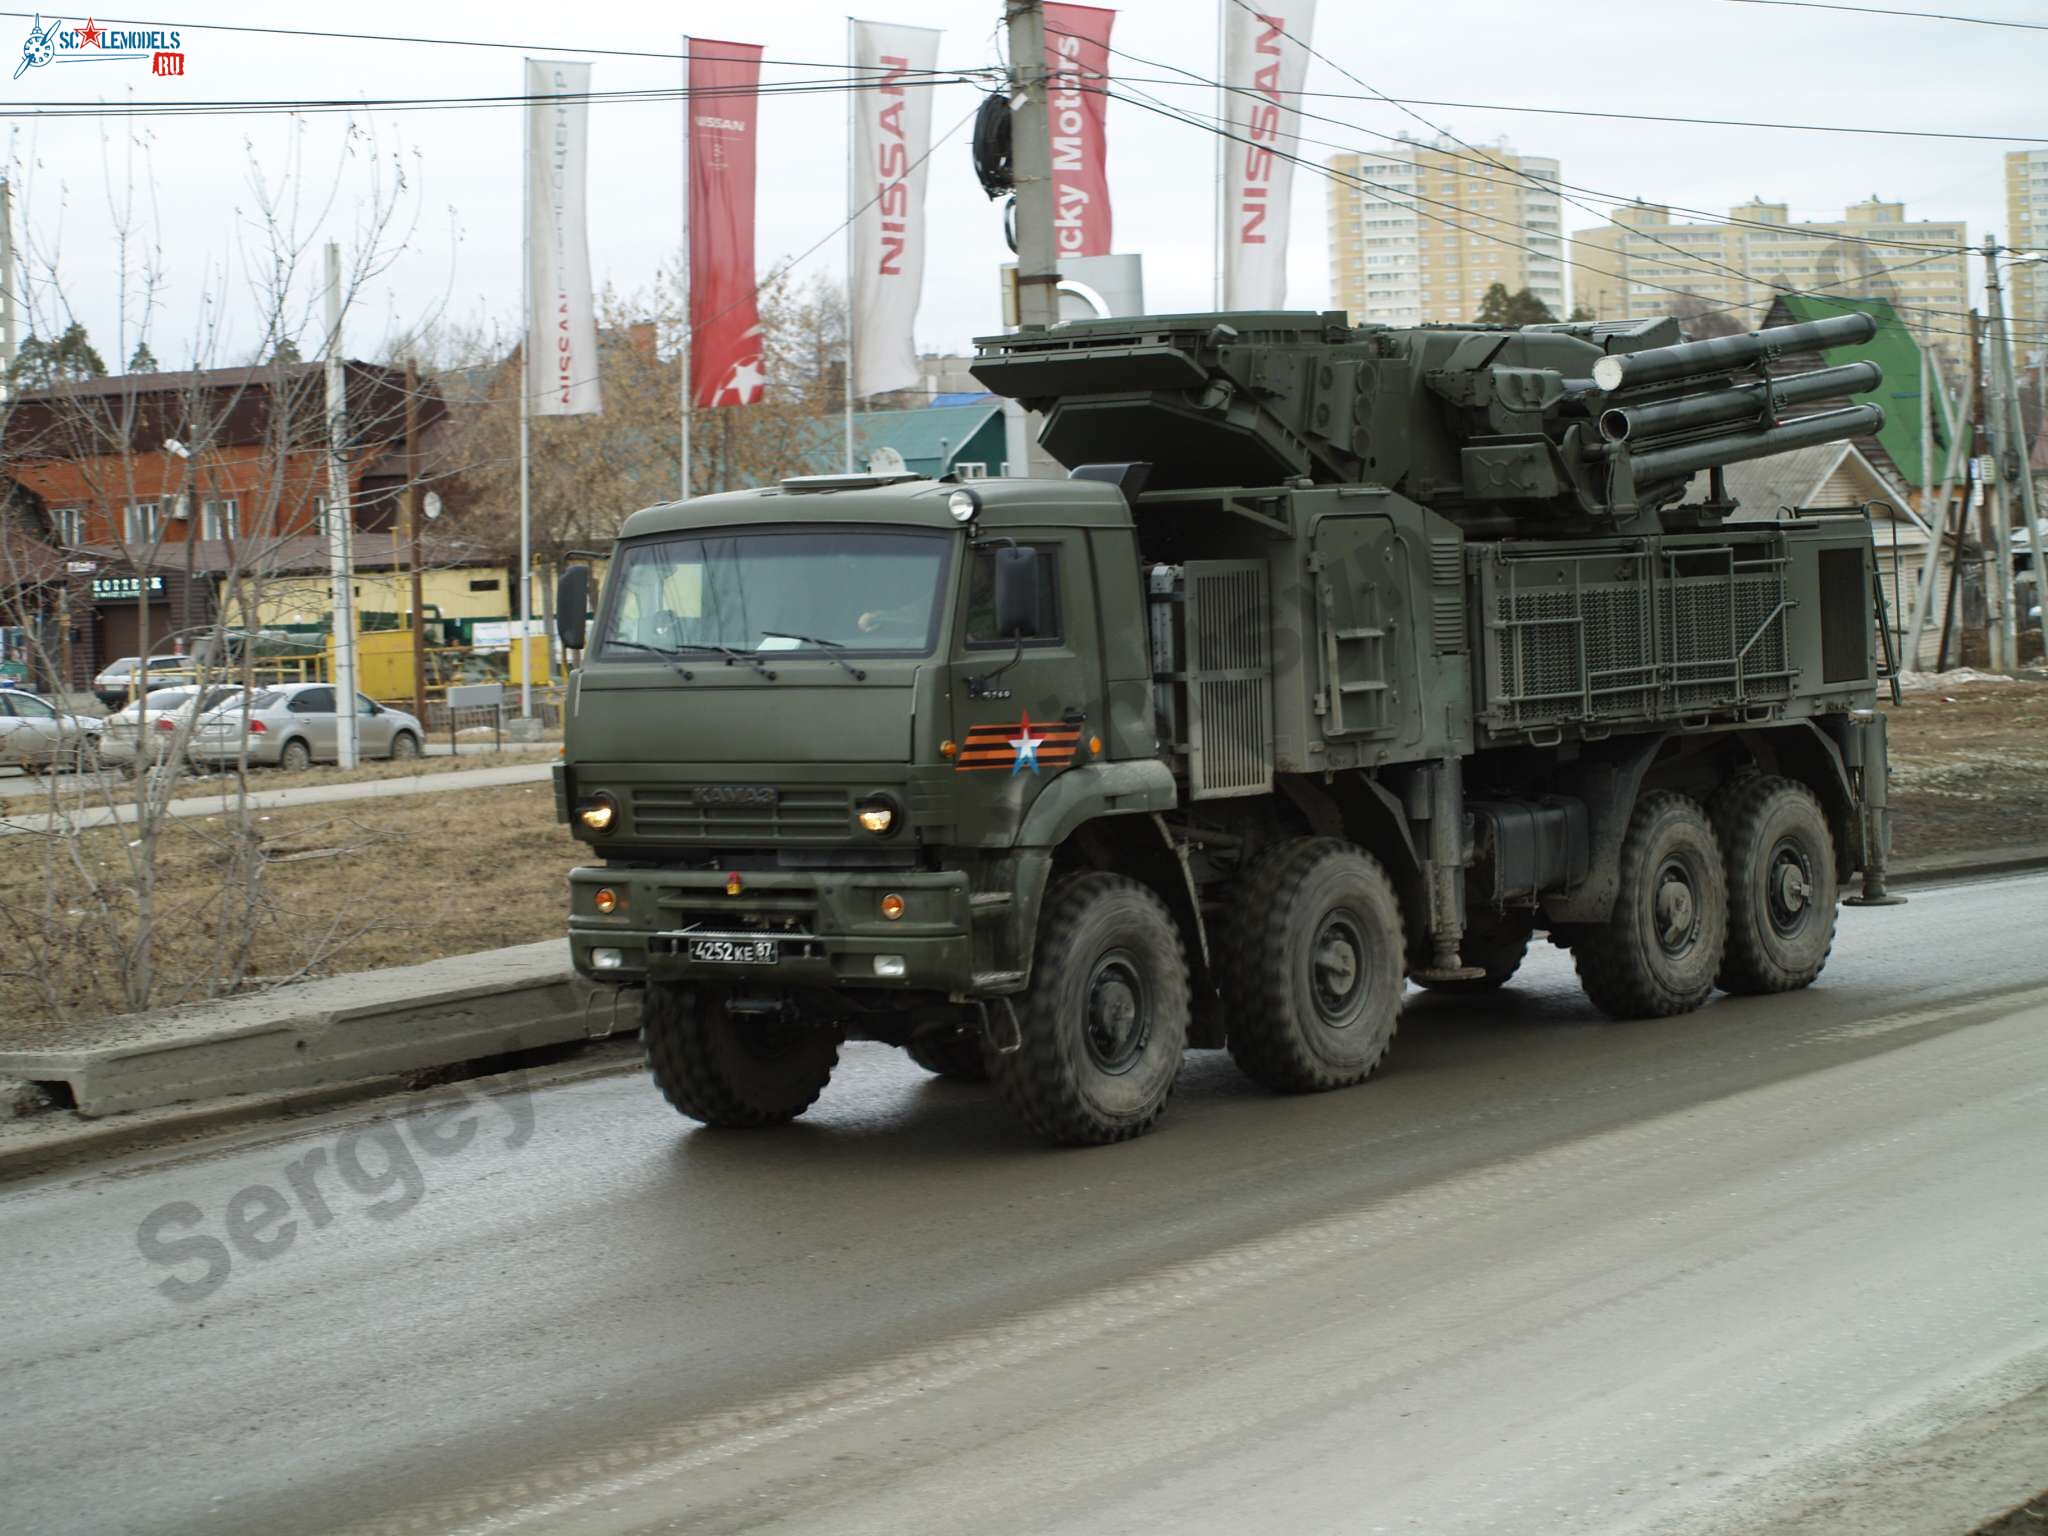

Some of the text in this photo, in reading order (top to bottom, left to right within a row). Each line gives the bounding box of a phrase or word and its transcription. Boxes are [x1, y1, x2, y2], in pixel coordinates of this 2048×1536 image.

[879, 55, 909, 275] NISSAN
[1052, 36, 1083, 171] Motors
[1241, 14, 1285, 244] NISSAN
[559, 294, 570, 404] NISSAN
